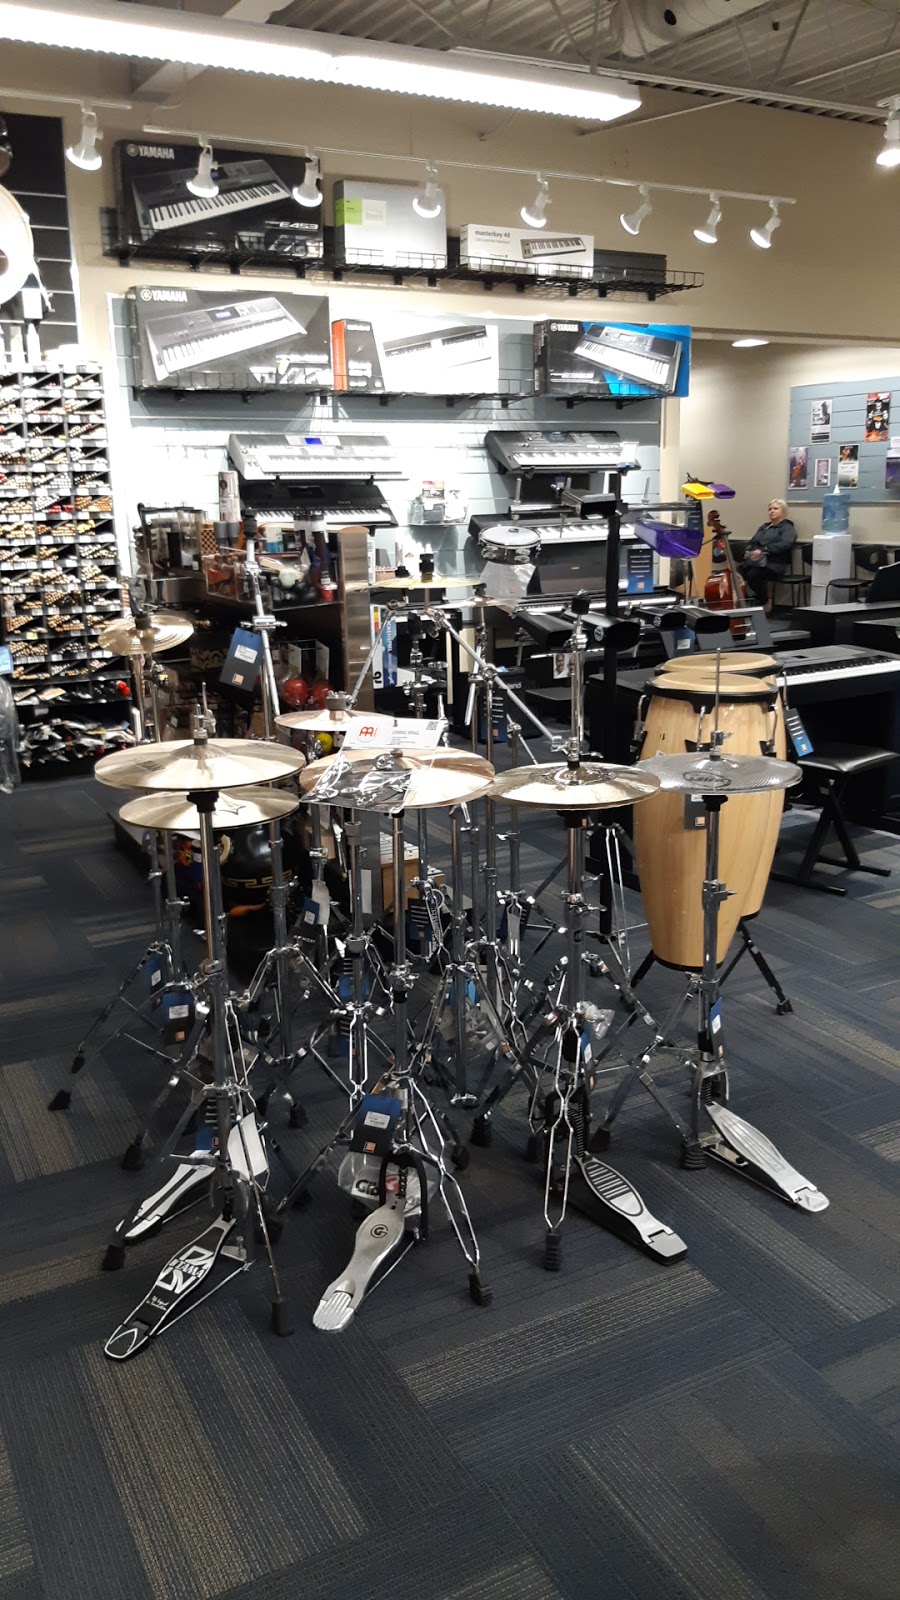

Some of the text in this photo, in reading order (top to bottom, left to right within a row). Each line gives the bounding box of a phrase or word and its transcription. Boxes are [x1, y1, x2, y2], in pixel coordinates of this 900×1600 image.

[138, 145, 175, 160] YAMAHA
[474, 229, 503, 239] masterkey
[152, 289, 188, 303] YAMAHA
[175, 1260, 206, 1278] TAMA
